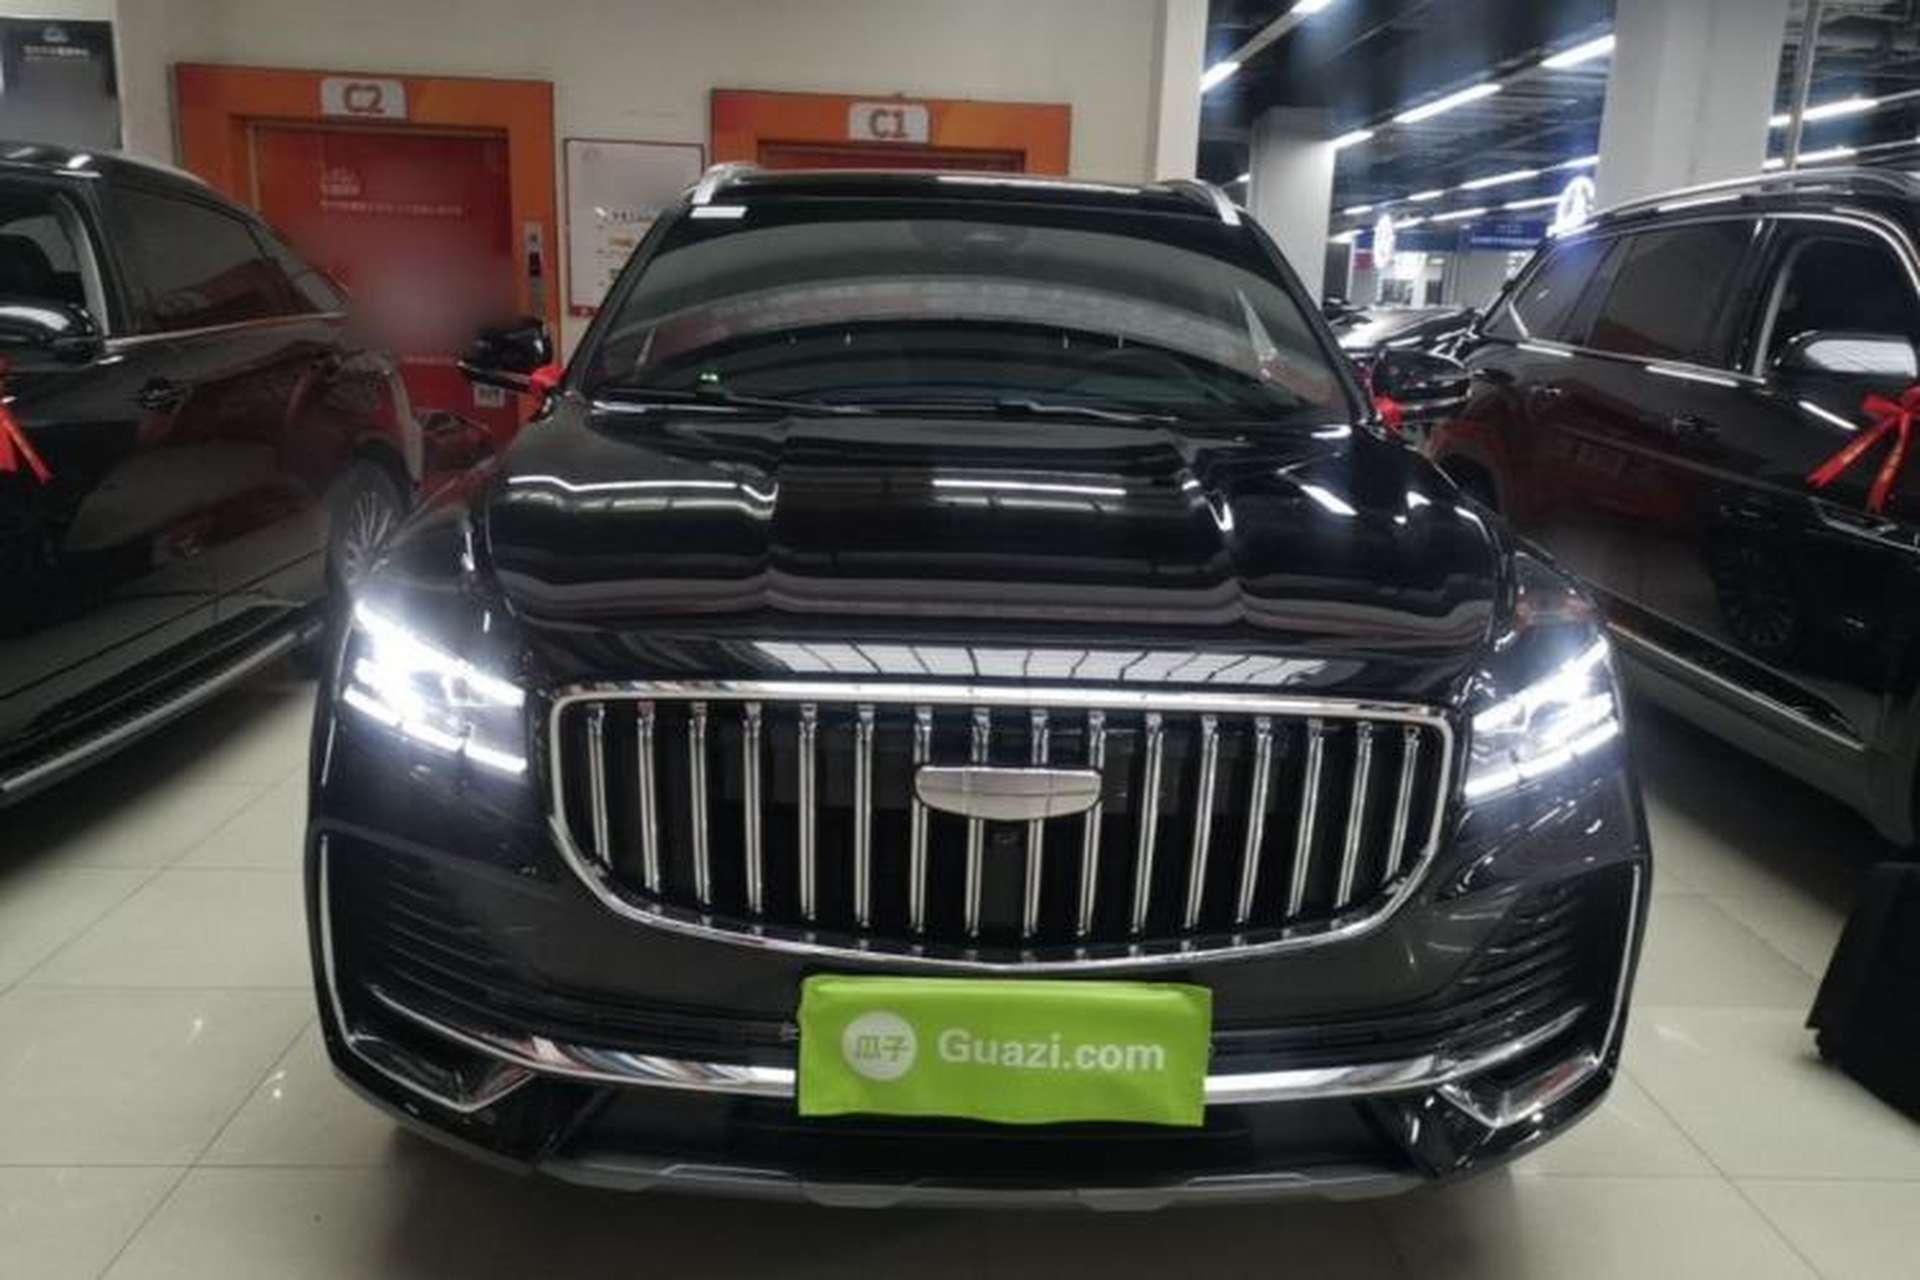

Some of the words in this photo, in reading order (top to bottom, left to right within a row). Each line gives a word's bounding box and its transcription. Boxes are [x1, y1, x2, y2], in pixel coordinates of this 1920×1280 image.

[344, 85, 384, 114] C2
[869, 110, 906, 138] C1
[856, 1034, 907, 1062] 瓜子
[938, 1028, 1164, 1070] Guazi.com
